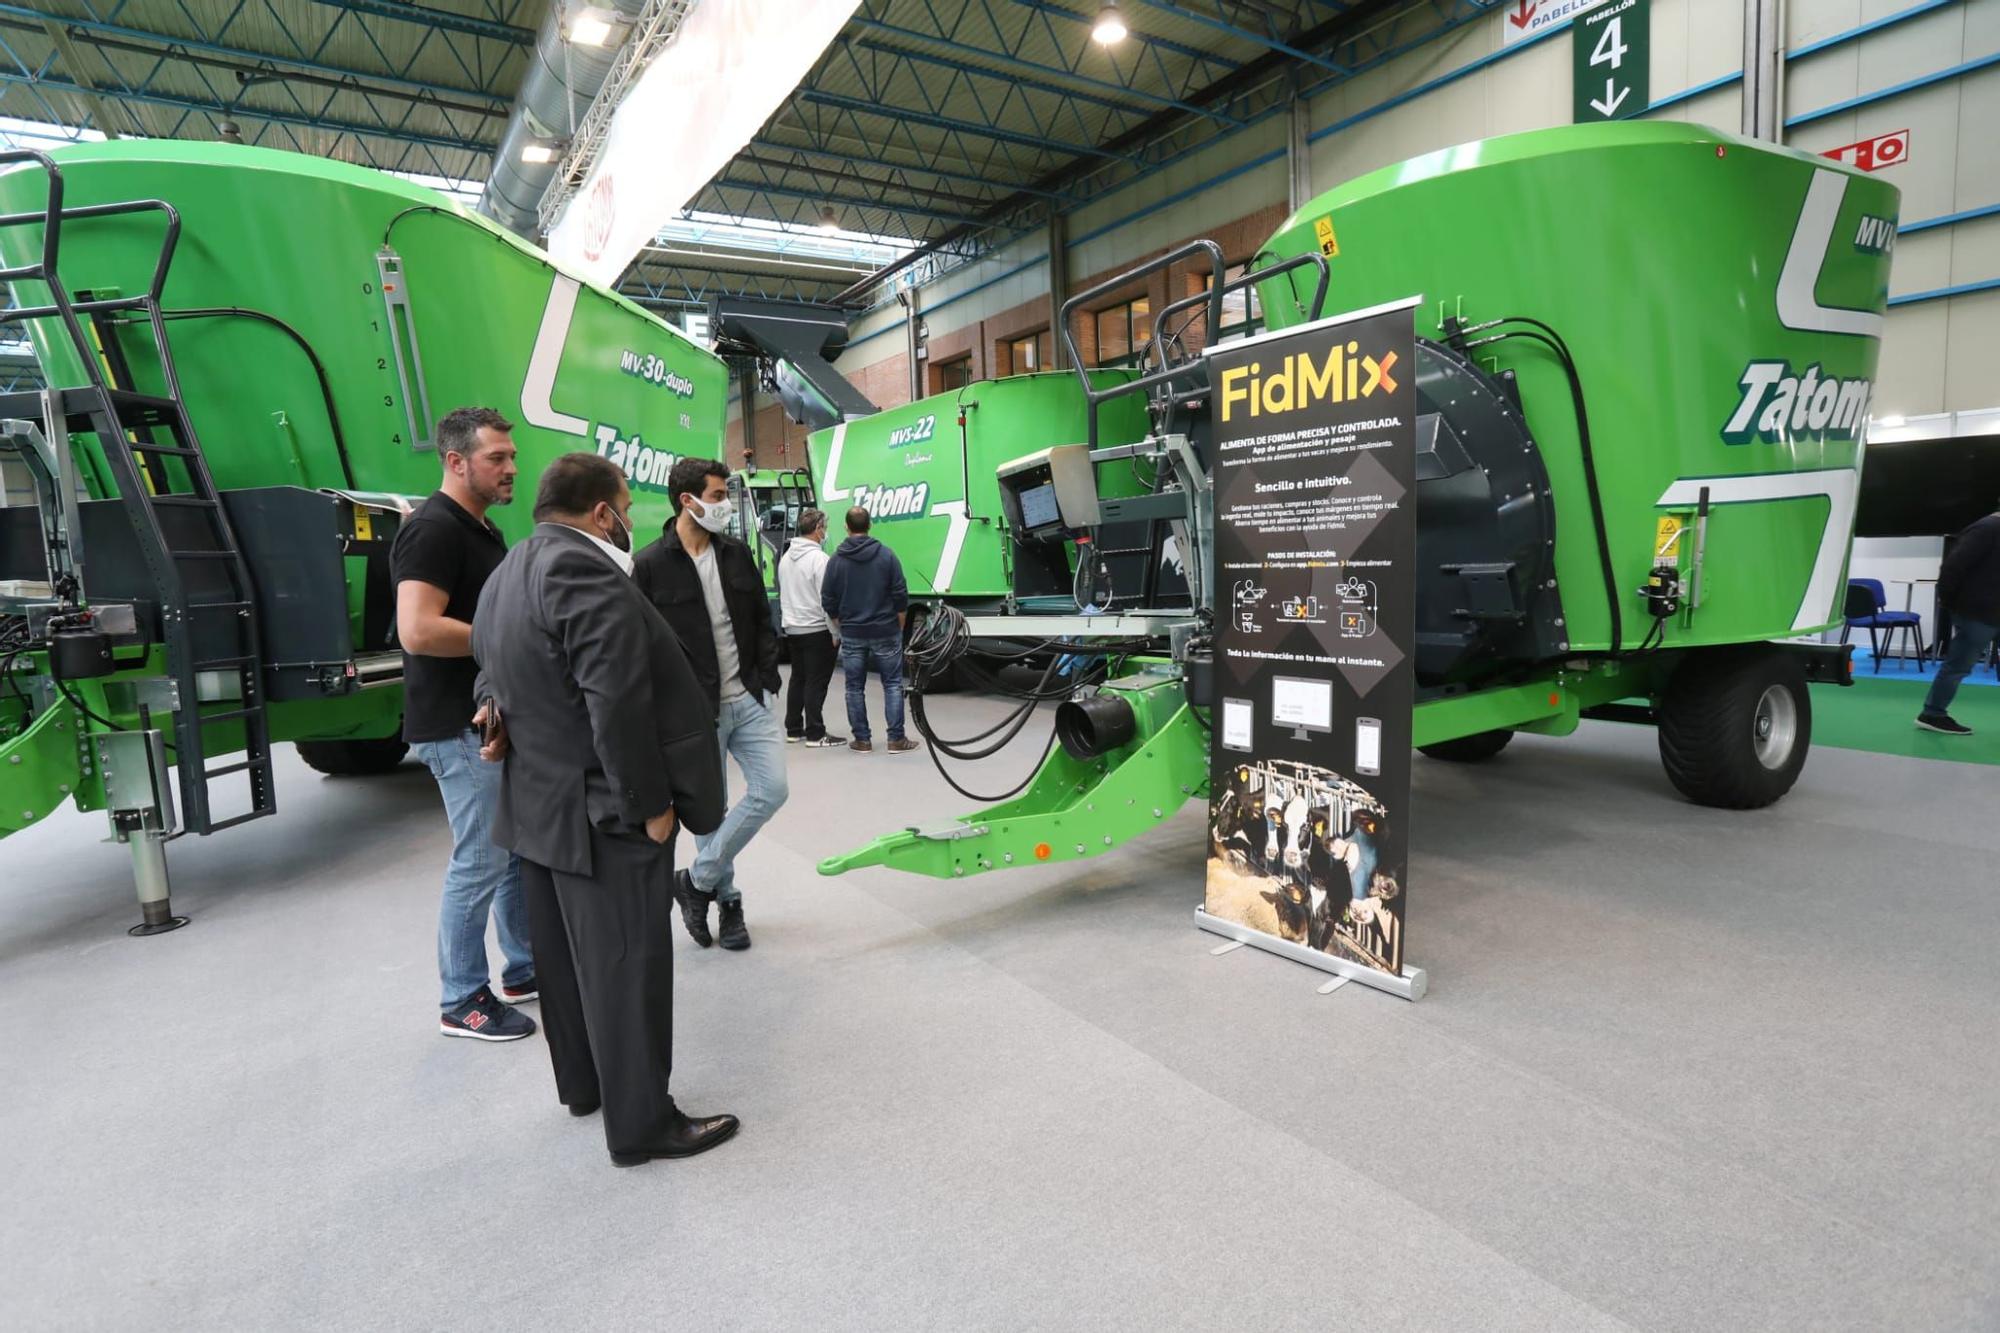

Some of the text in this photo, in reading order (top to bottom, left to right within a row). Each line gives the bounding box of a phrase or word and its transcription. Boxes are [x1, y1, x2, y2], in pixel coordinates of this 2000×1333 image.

[1590, 16, 1627, 69] 4
[363, 283, 372, 295] 0
[371, 321, 379, 332] 1
[377, 358, 386, 369] 2
[1222, 341, 1398, 422] FidMix
[384, 396, 393, 407] 3
[1722, 362, 1873, 433] Tatom
[392, 434, 401, 445] 4
[1220, 417, 1401, 450] ALIMENTA DE FORMA PRECISA Y CONTROLADA.
[1252, 446, 1266, 455] App
[1277, 439, 1323, 451] alimentación
[1330, 434, 1356, 445] pesaje
[596, 425, 685, 487] Tatom
[1255, 476, 1352, 493] Sencillo e intuitivo.
[853, 482, 928, 519] Tatoma
[1227, 648, 1242, 656] Toda
[1251, 650, 1294, 660] información
[1315, 656, 1336, 664] mano
[1347, 656, 1384, 666] instante.
